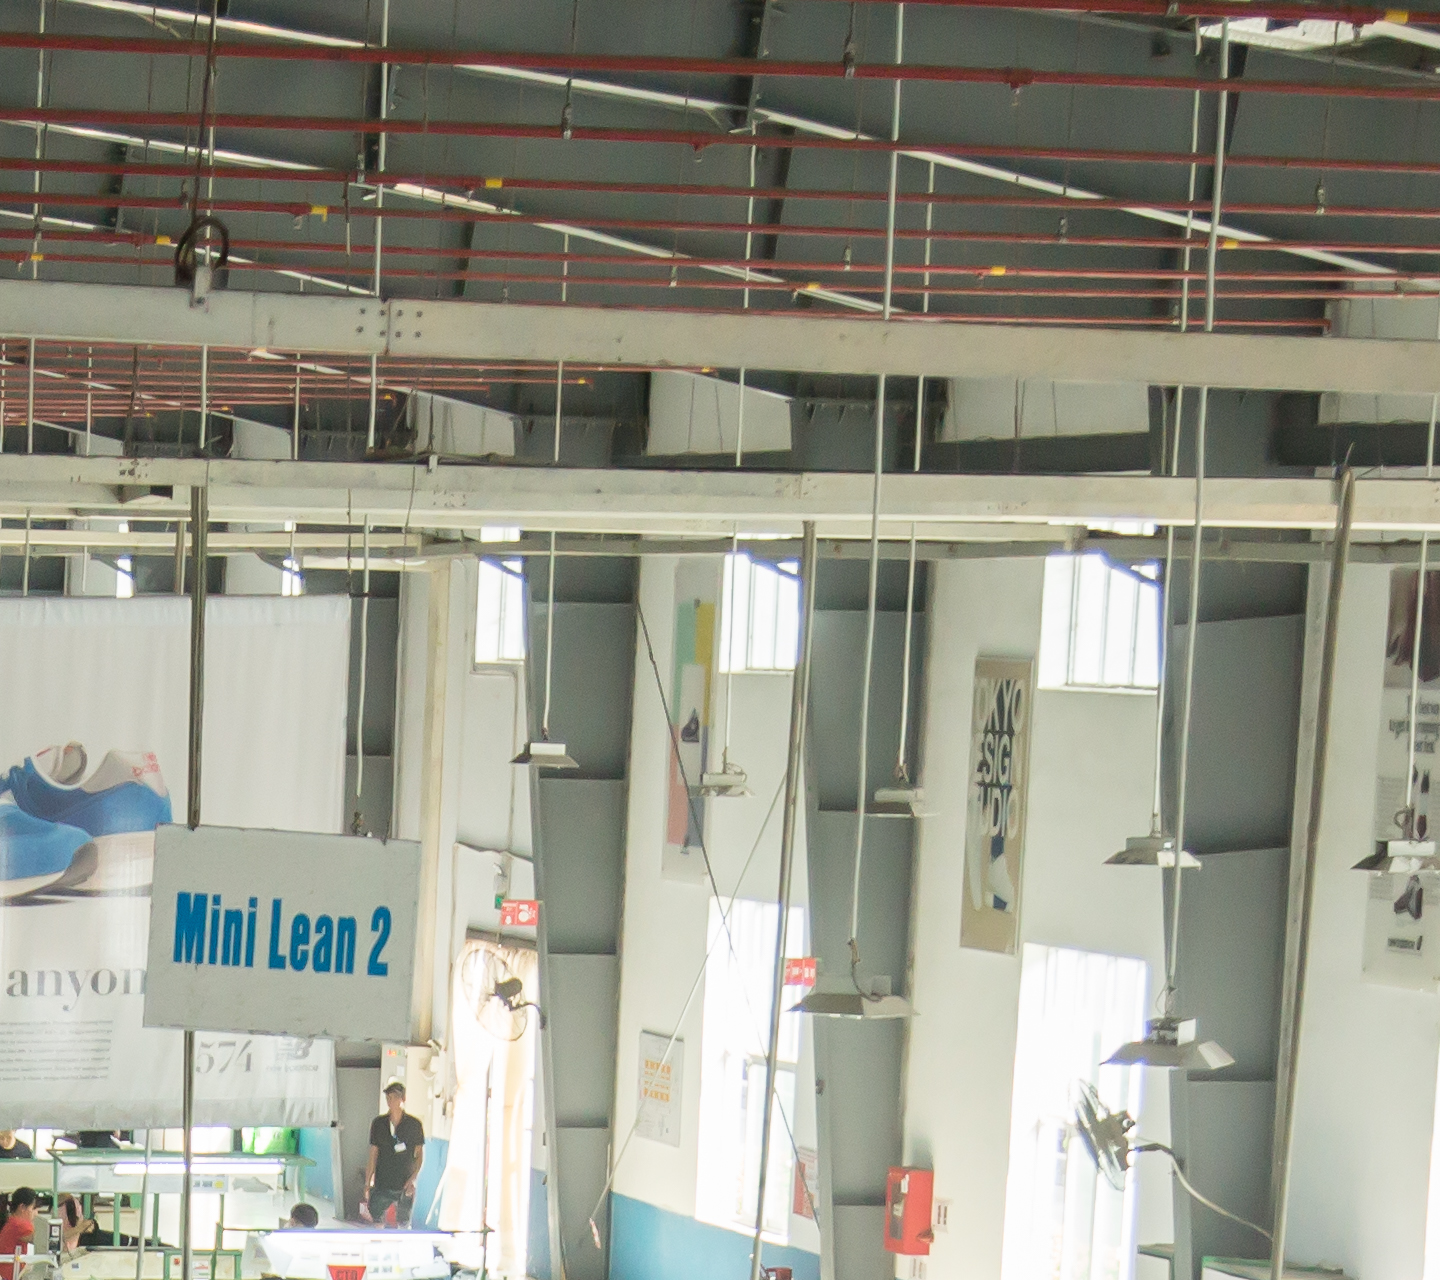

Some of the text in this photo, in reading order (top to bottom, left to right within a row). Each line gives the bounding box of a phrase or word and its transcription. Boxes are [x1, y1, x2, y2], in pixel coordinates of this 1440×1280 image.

[173, 891, 392, 977] Mini Lean 2
[5, 966, 147, 1013] anyon
[196, 1039, 253, 1074] 574
